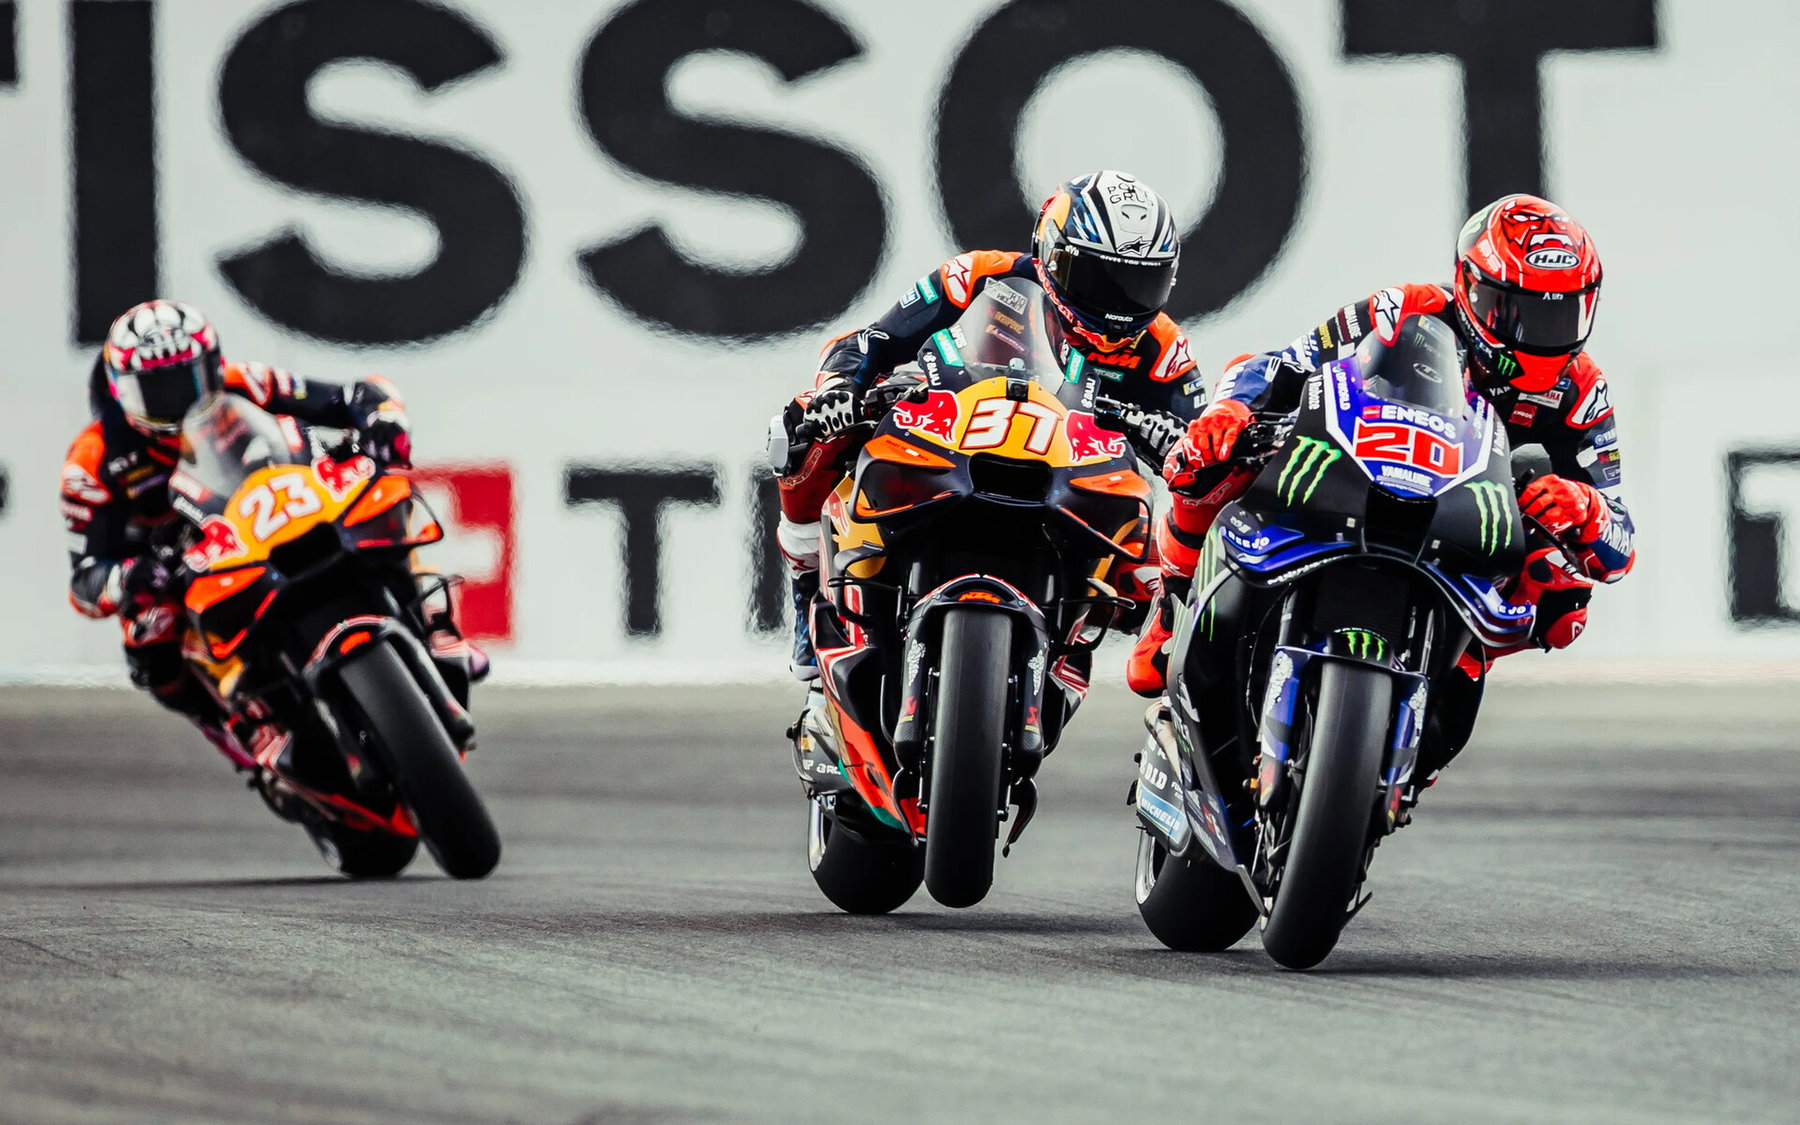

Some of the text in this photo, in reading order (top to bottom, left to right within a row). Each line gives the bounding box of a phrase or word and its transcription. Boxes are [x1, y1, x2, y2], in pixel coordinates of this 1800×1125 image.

[0, 0, 1659, 347] ISSOT
[1533, 254, 1573, 265] HJC
[1105, 312, 1134, 323] Norauto
[958, 396, 1064, 455] 37
[1353, 417, 1464, 478] 20
[1381, 405, 1456, 439] ENEOS
[239, 472, 322, 541] 23
